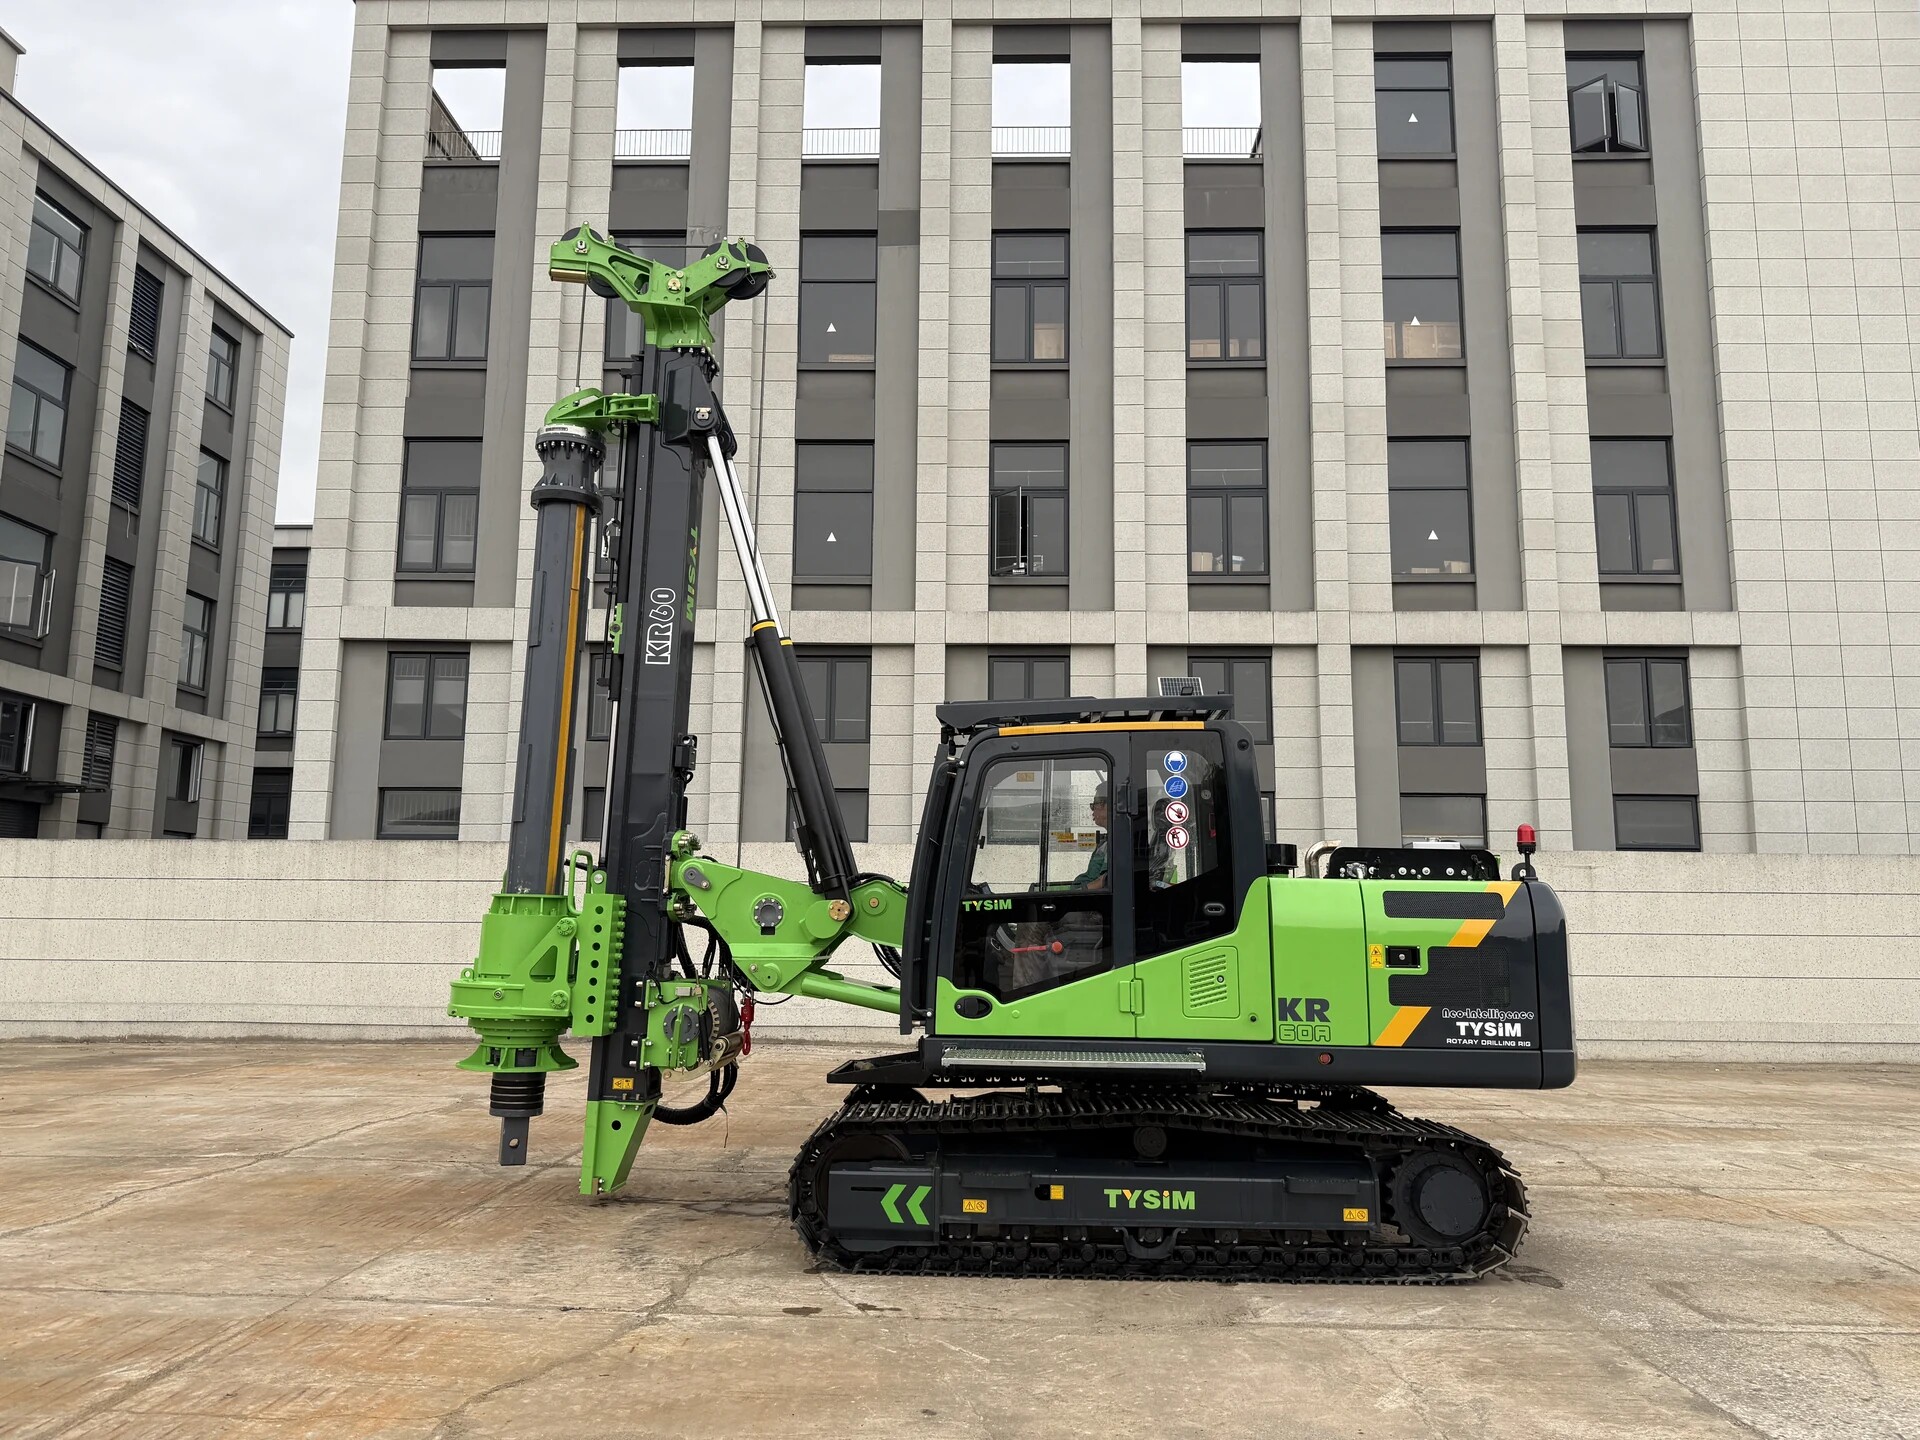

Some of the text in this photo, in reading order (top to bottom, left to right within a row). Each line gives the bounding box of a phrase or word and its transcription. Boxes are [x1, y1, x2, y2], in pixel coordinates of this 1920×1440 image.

[645, 587, 676, 665] KR60
[1278, 997, 1331, 1022] KR
[1278, 1024, 1331, 1042] 60A
[1480, 1039, 1516, 1047] DRILLING
